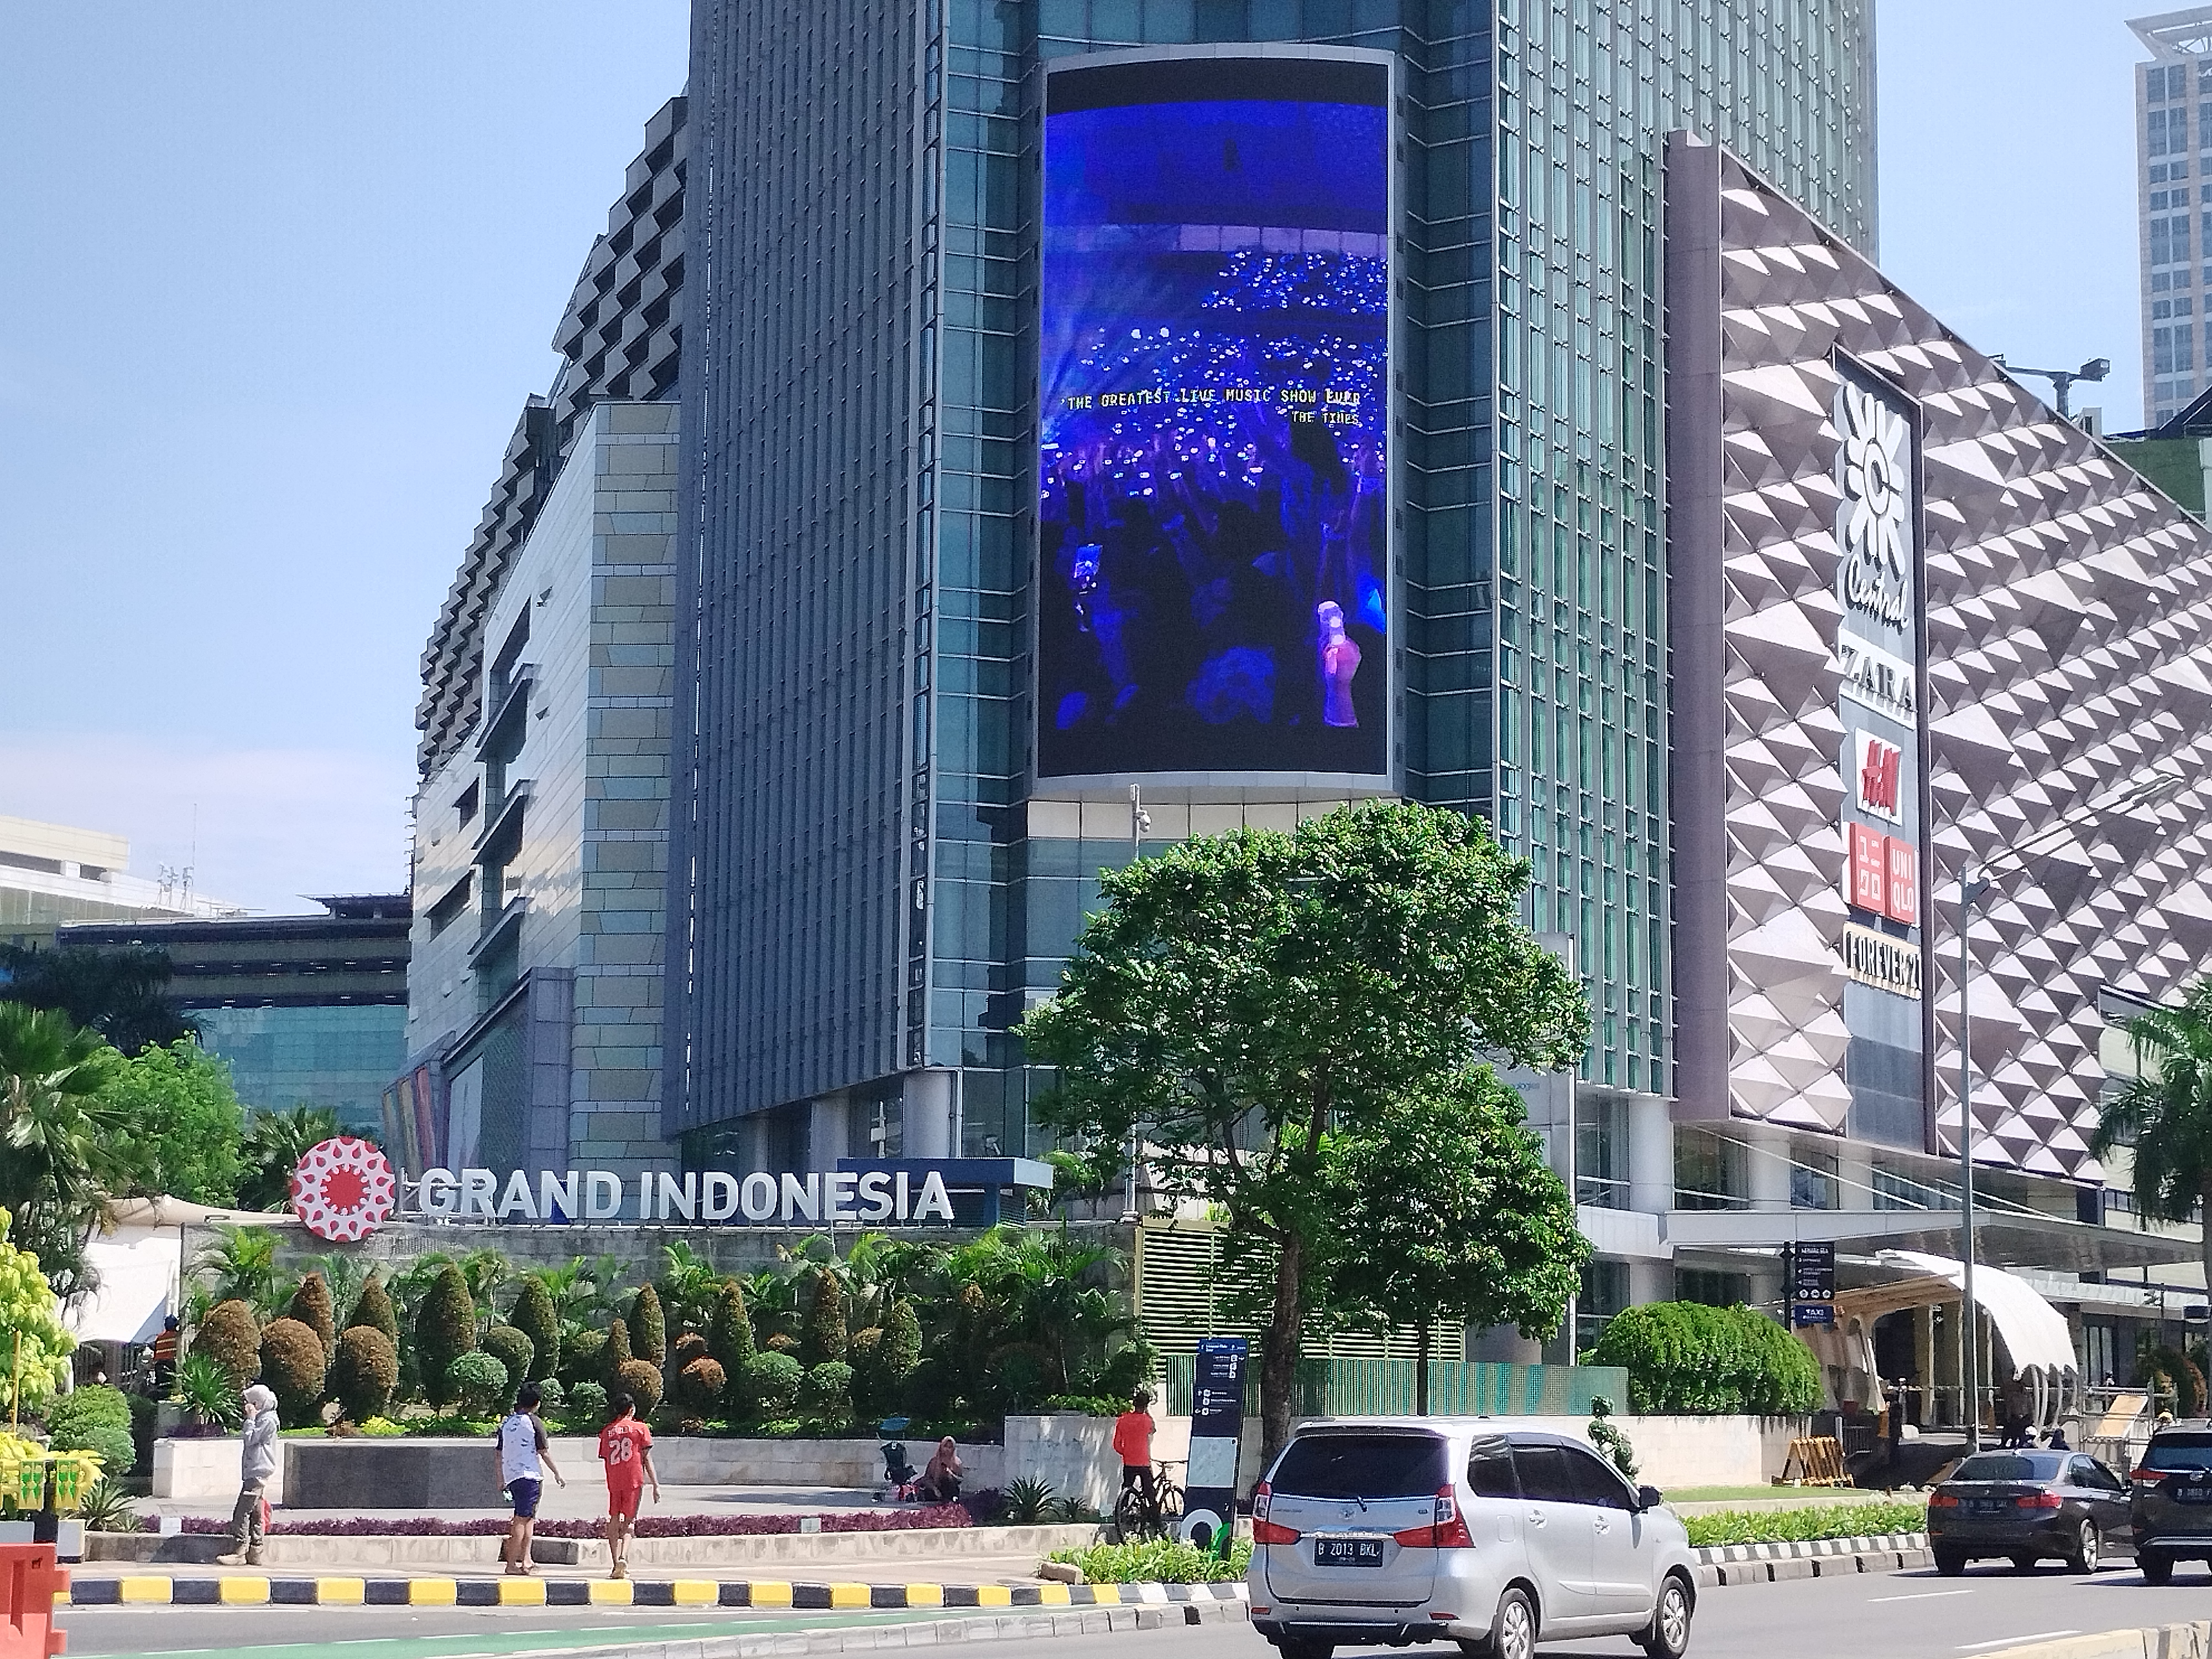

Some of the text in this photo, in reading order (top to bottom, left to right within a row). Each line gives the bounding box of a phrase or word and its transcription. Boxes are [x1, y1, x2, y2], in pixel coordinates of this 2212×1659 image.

[1100, 389, 1171, 408] GREATEST
[1180, 388, 1217, 403] LIVE
[1225, 389, 1271, 403] MUSIC
[1280, 389, 1317, 403] SHOW
[1841, 645, 1913, 708] ZARA
[418, 1168, 956, 1220] GRAND INDONESIA
[608, 1437, 633, 1465] 28
[1318, 1543, 1324, 1556] B
[1330, 1543, 1353, 1556] 2013
